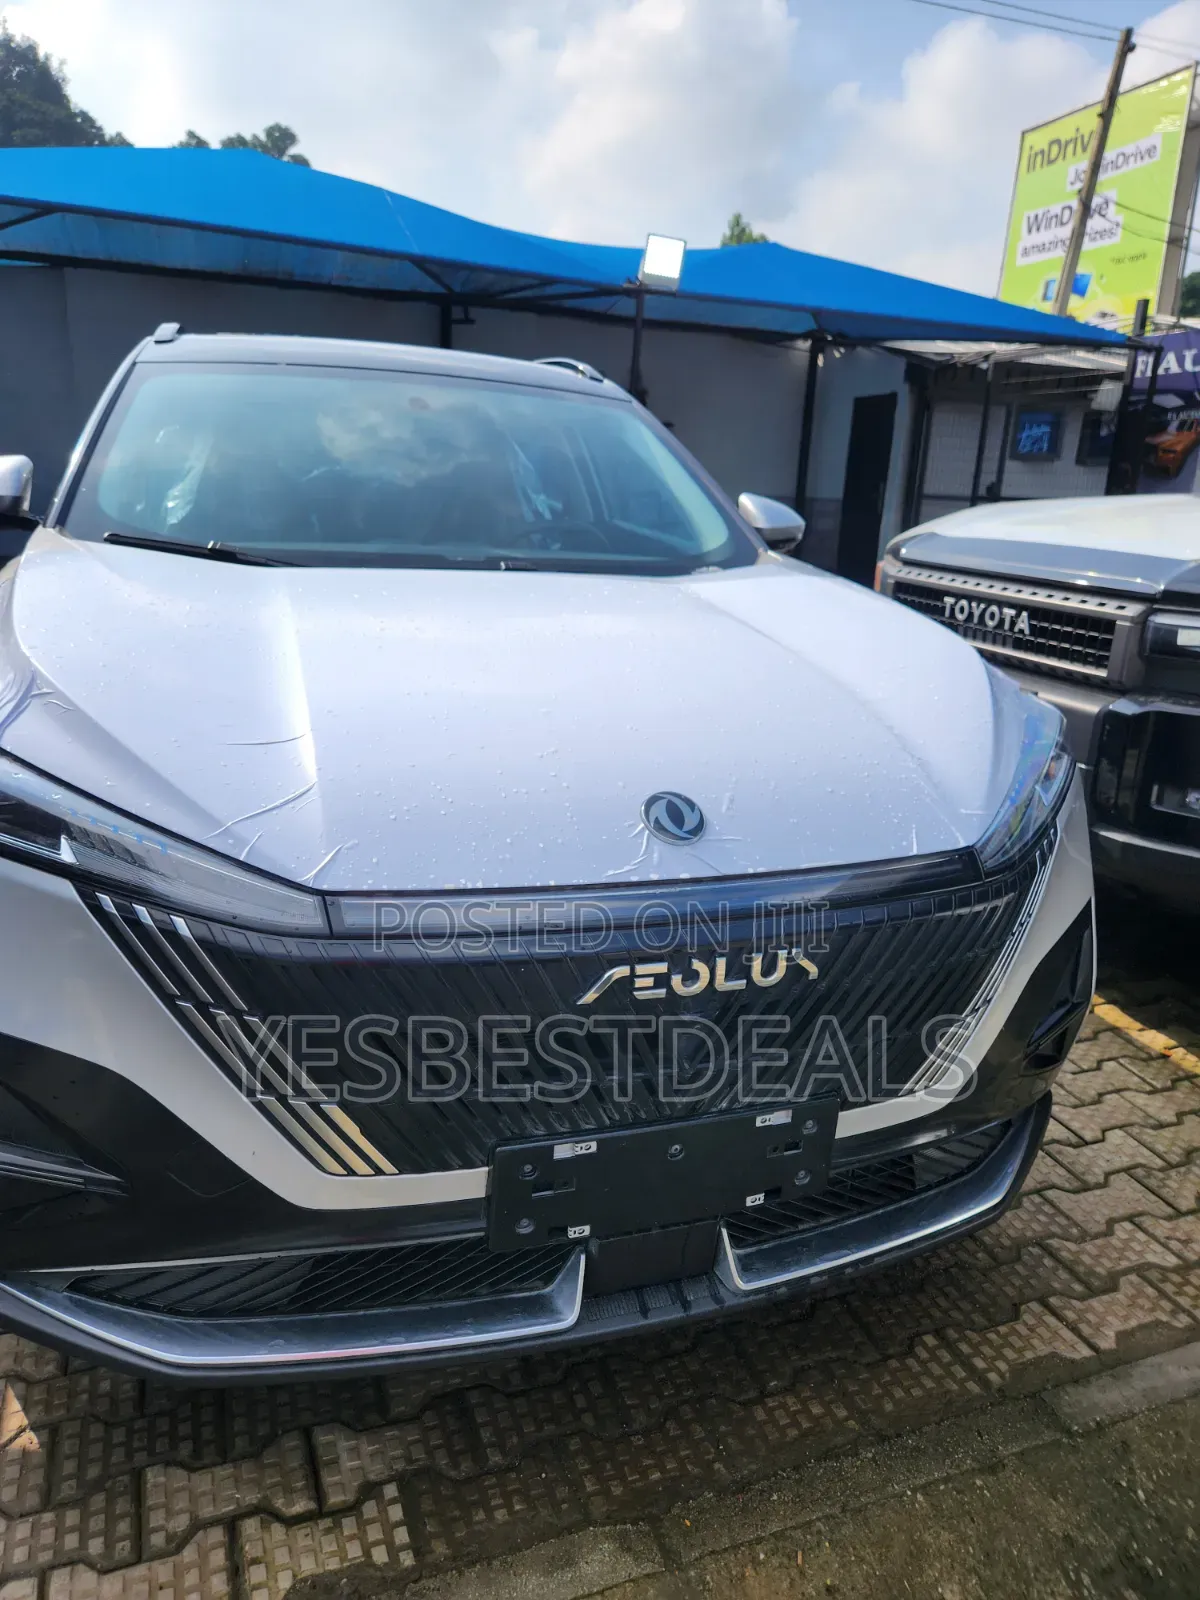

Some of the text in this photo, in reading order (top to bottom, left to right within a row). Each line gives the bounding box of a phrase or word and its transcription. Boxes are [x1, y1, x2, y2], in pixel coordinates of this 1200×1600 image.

[1026, 128, 1095, 173] inDriv
[1026, 198, 1110, 235] WinDve
[943, 595, 1030, 635] TOYOTA
[576, 947, 819, 1005] AEOLUS
